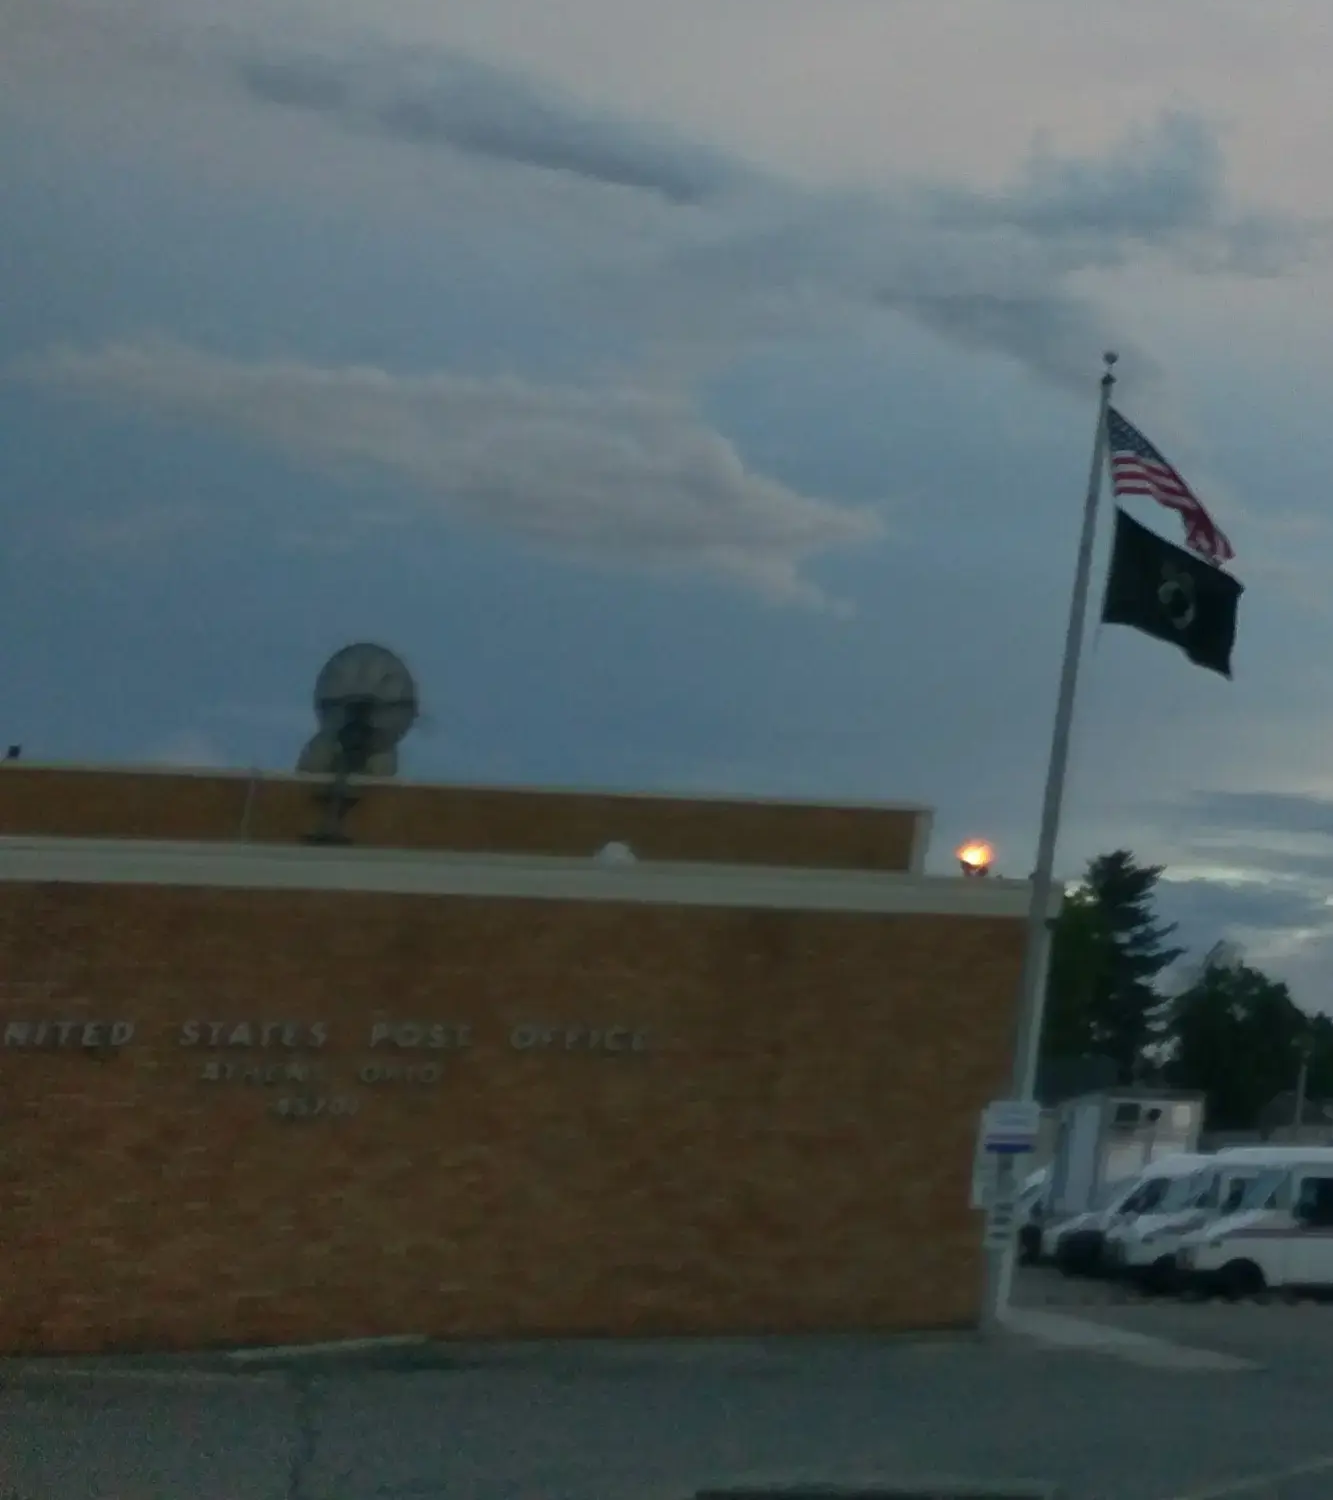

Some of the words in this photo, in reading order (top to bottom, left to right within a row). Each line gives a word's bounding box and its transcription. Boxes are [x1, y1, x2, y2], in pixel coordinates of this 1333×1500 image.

[178, 1020, 329, 1048] STATES
[368, 1022, 472, 1048] POST
[509, 1022, 648, 1051] OFFICE
